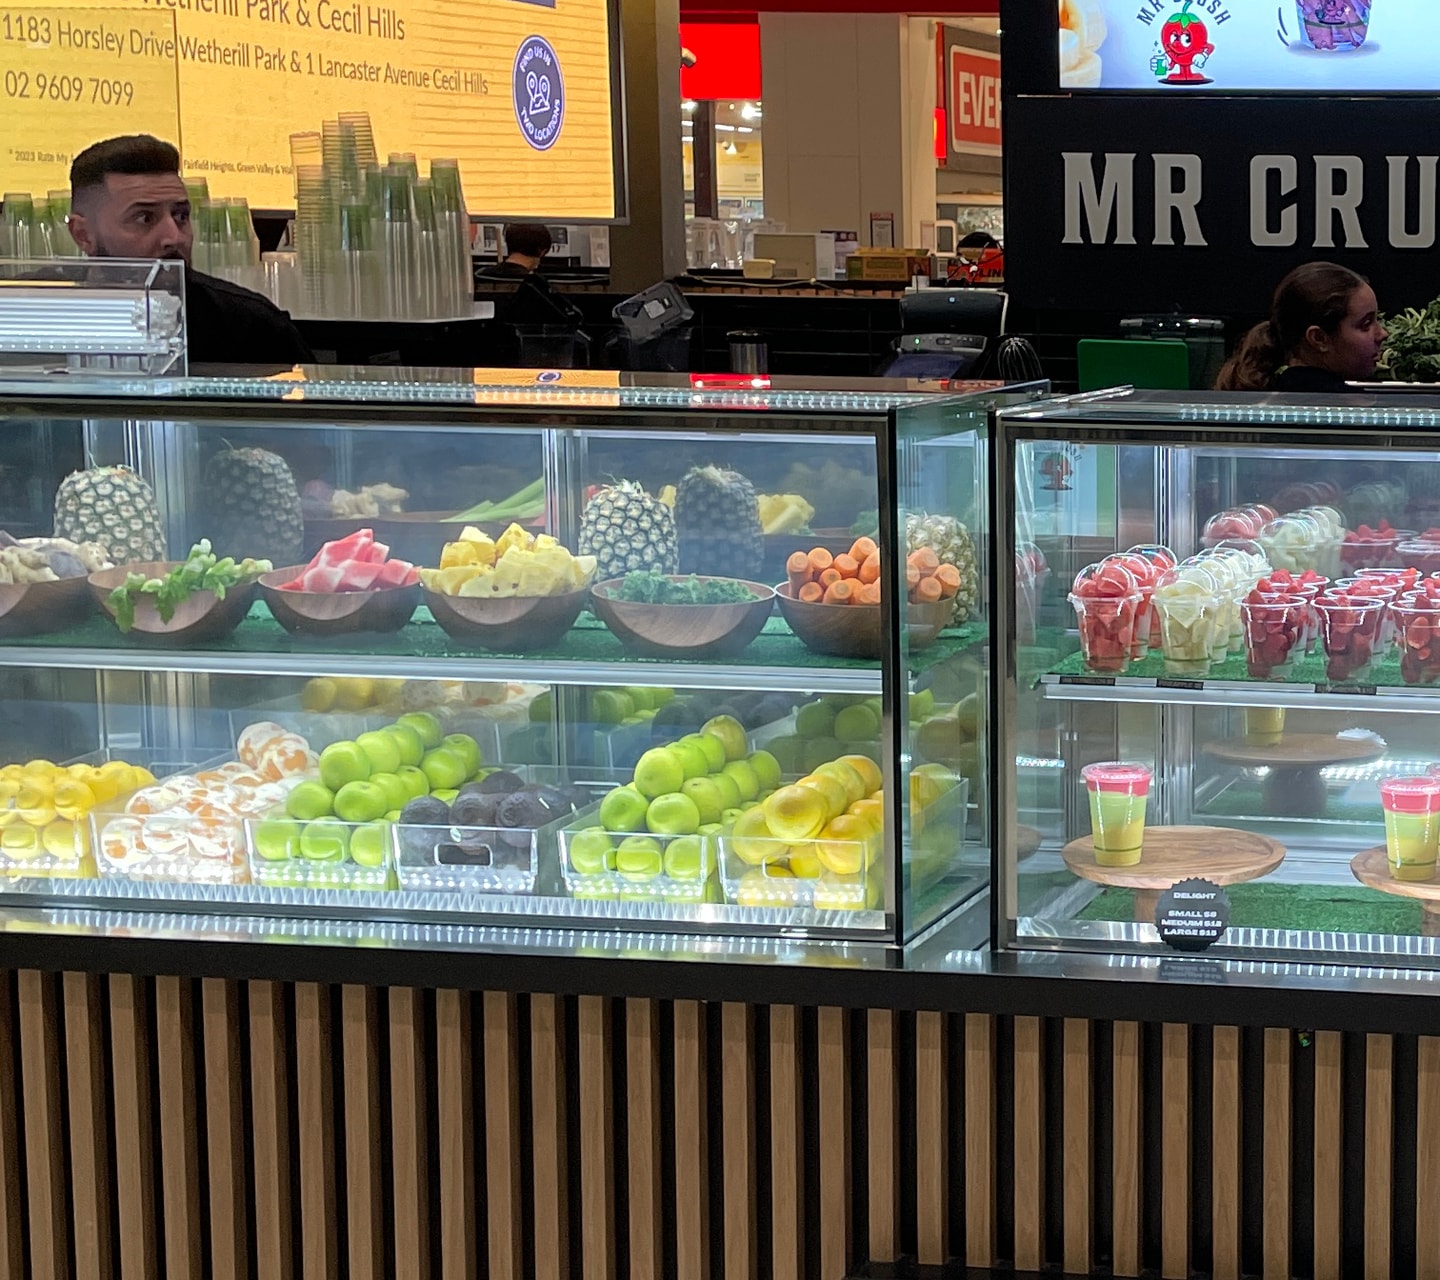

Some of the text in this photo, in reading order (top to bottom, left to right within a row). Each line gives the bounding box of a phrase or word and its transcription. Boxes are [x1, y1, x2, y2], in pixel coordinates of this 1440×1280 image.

[367, 6, 406, 41] Hills
[3, 12, 489, 97] 1183 Horsley Drive Wetherill Park & 1 Lancaster Avenue Cecil Hills
[5, 70, 134, 107] 02 9609 7099
[1061, 152, 1208, 247] MR
[1173, 892, 1217, 900] DELIGHT
[1168, 910, 1203, 918] SMALL
[1164, 928, 1199, 936] LARGE
